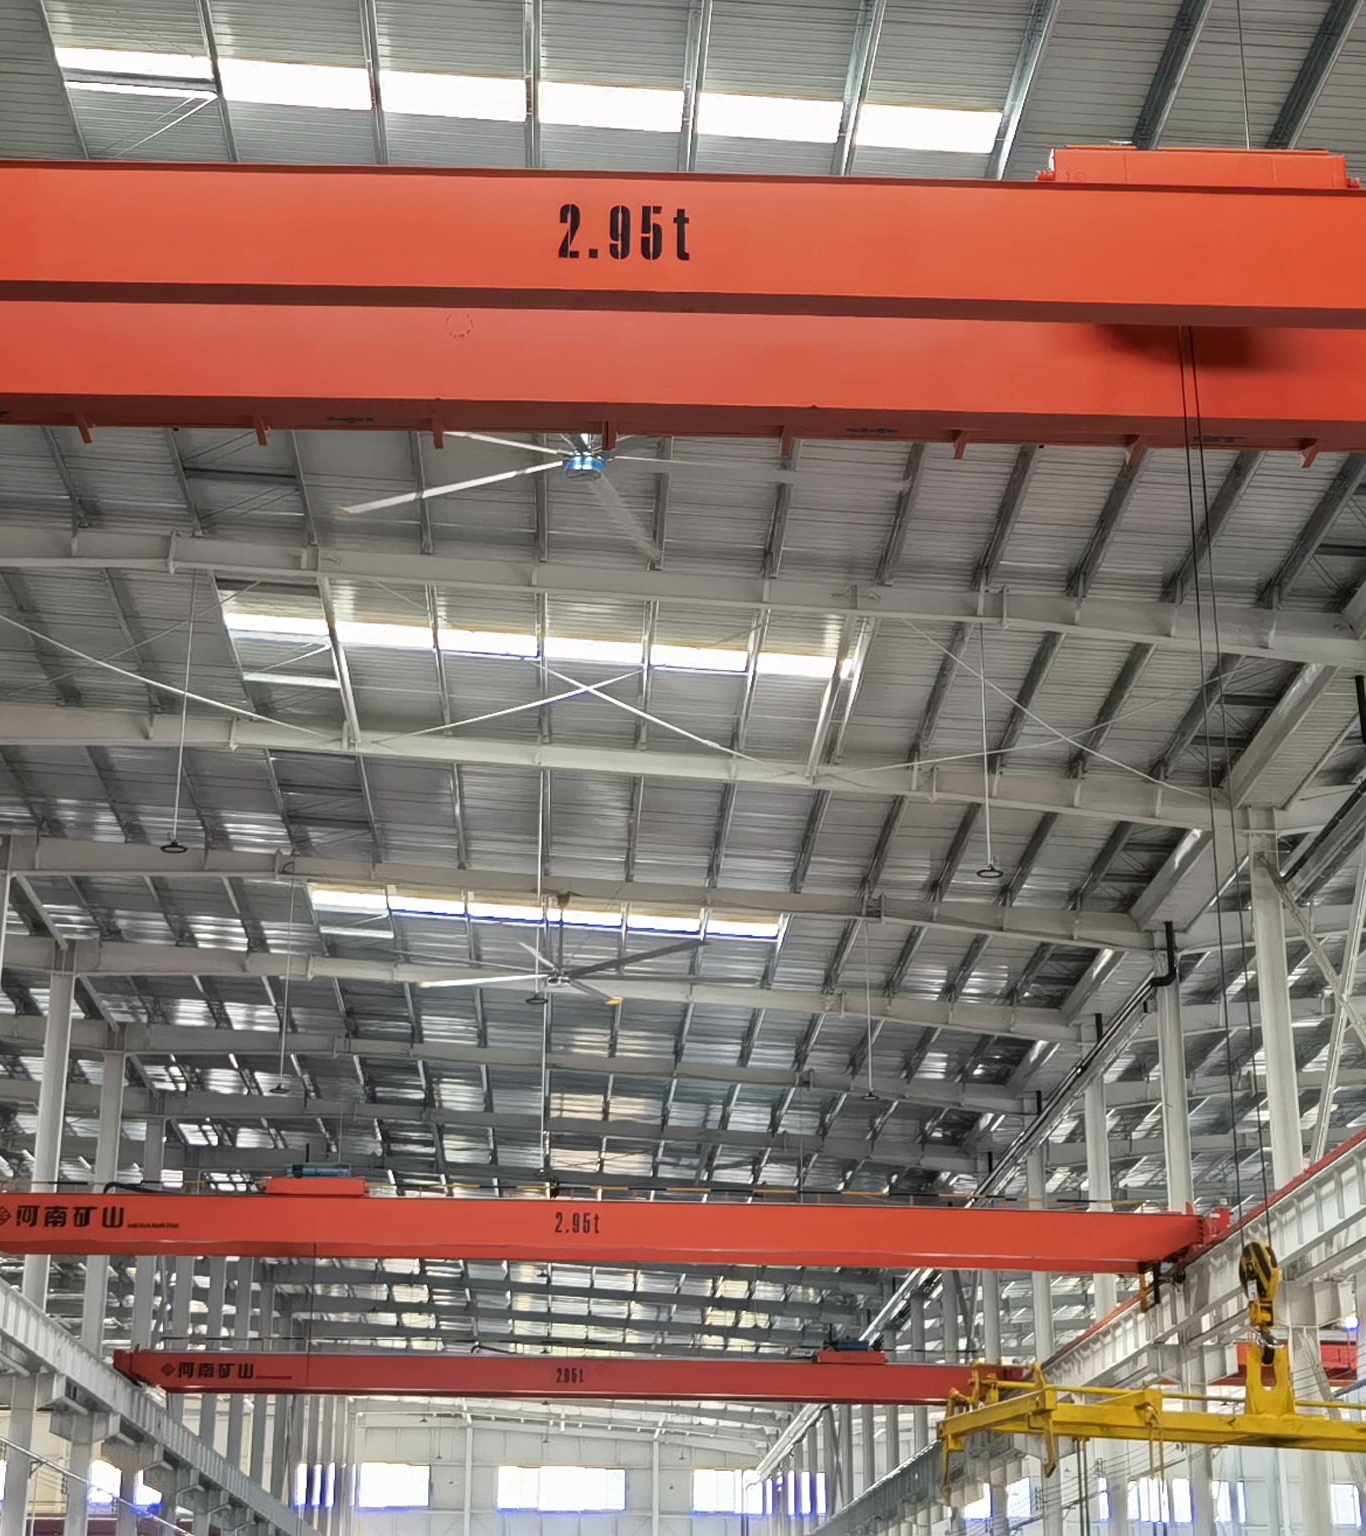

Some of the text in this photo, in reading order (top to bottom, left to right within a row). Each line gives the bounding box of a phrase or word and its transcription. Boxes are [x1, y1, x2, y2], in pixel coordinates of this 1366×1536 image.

[558, 203, 691, 261] 2.95t
[16, 1205, 125, 1228] 河南矿山
[555, 1211, 600, 1234] 2.95t
